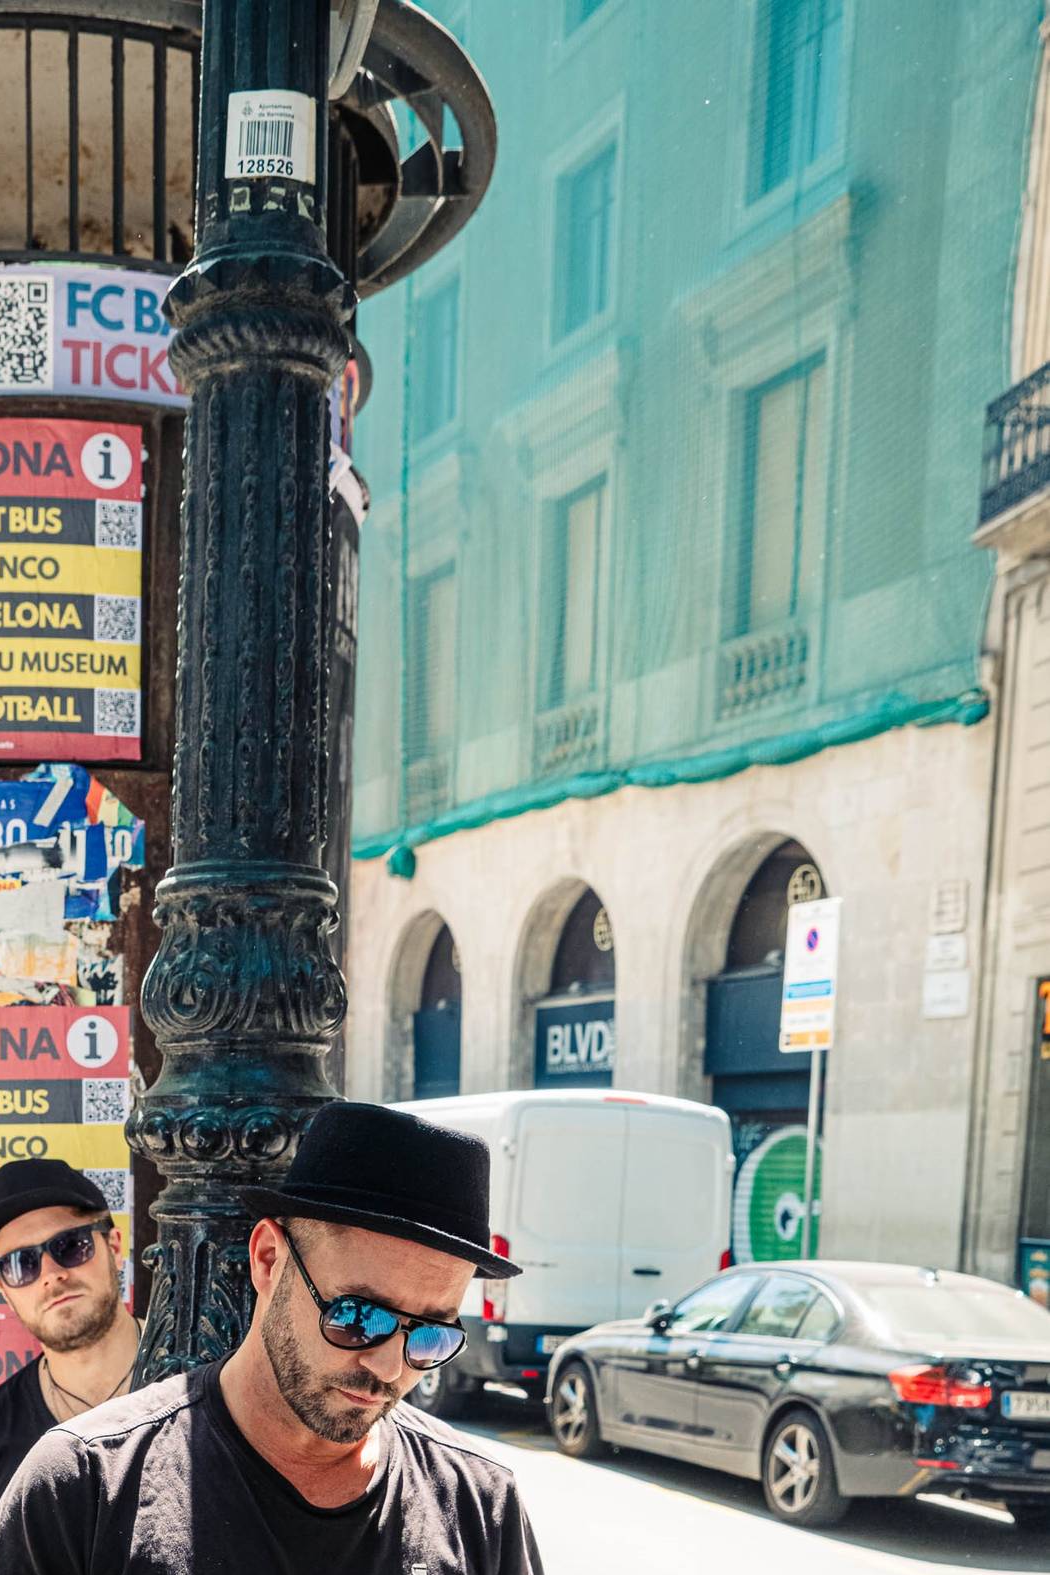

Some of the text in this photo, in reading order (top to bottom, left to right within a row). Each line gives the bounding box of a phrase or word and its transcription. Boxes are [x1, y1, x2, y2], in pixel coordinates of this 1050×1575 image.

[238, 159, 293, 175] 128526
[67, 282, 125, 331] FC
[9, 507, 62, 534] BUS
[21, 652, 127, 675] MUSEUM
[547, 1020, 609, 1065] BLVD
